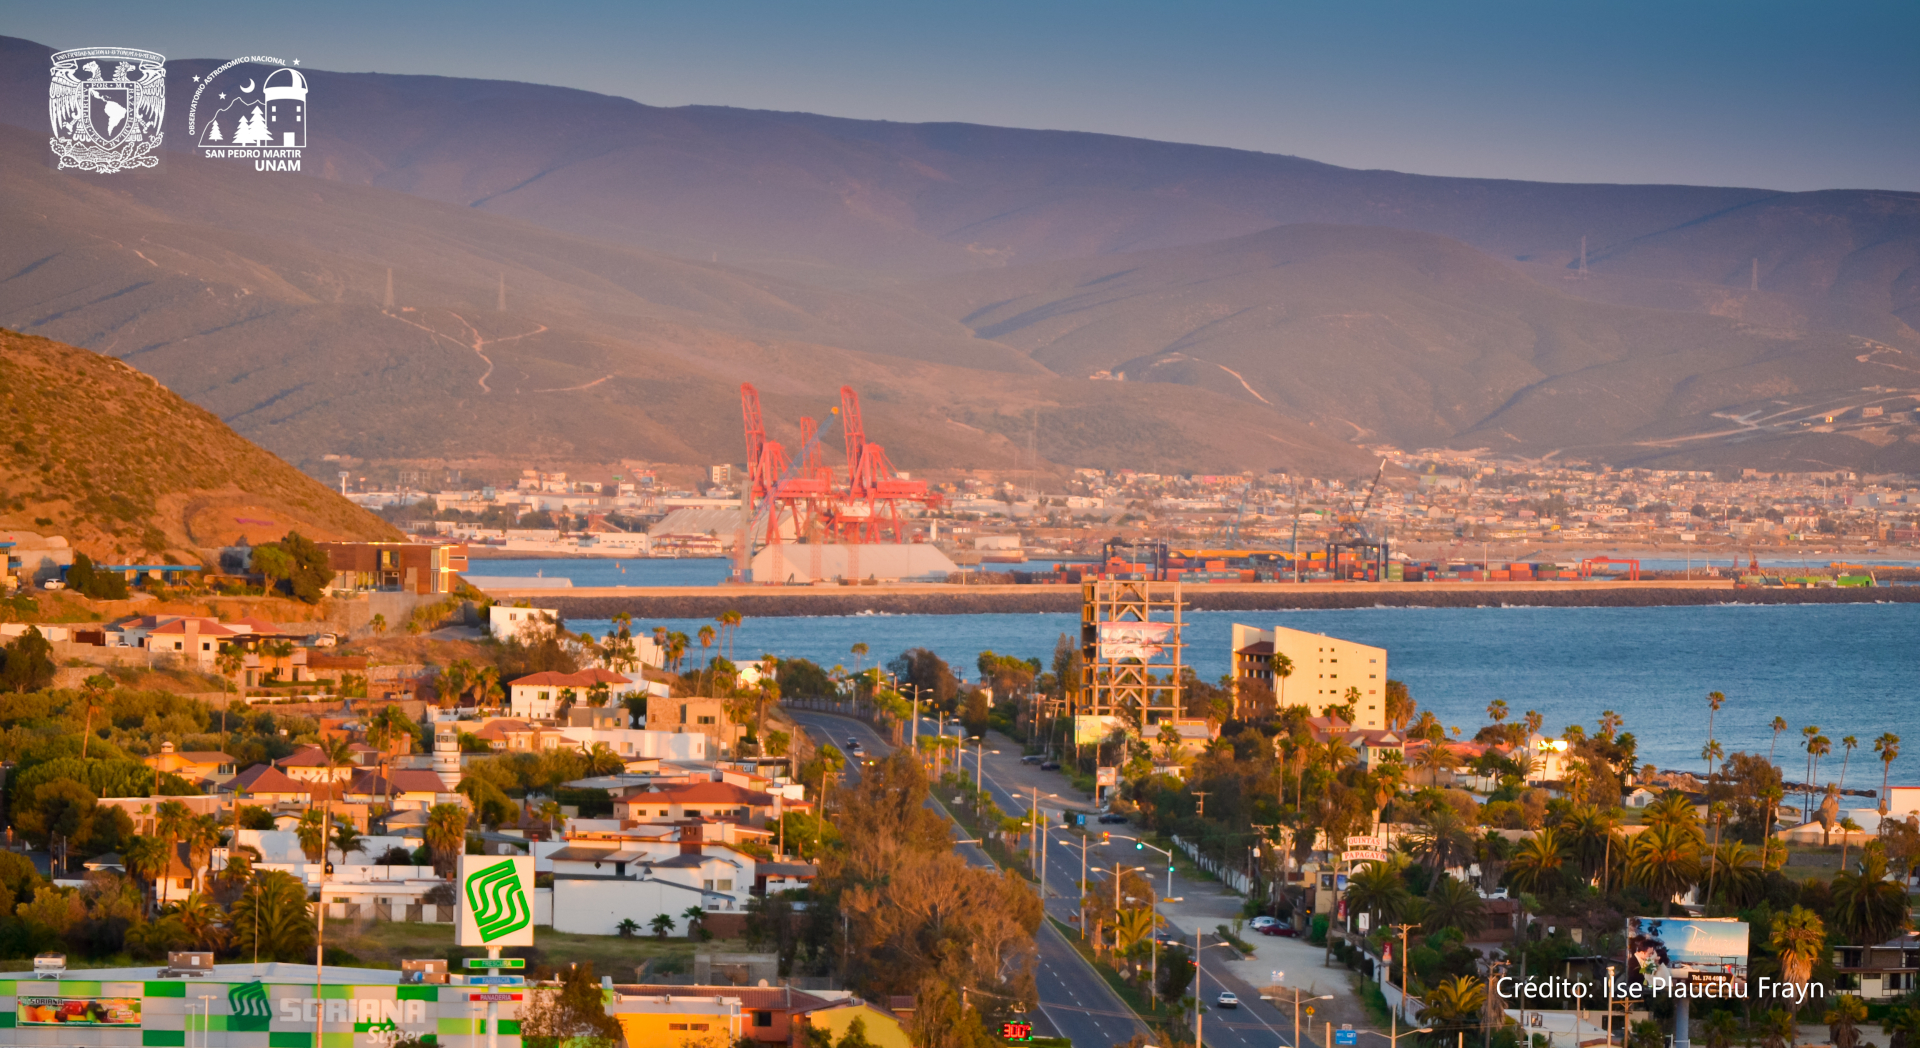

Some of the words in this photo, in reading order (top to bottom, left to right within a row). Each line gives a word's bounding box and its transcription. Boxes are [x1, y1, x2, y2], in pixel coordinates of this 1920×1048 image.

[1344, 852, 1385, 860] PAPAGAYO
[482, 959, 512, 968] FRESCURA
[279, 998, 426, 1024] SORIANA
[366, 1024, 425, 1048] Súper
